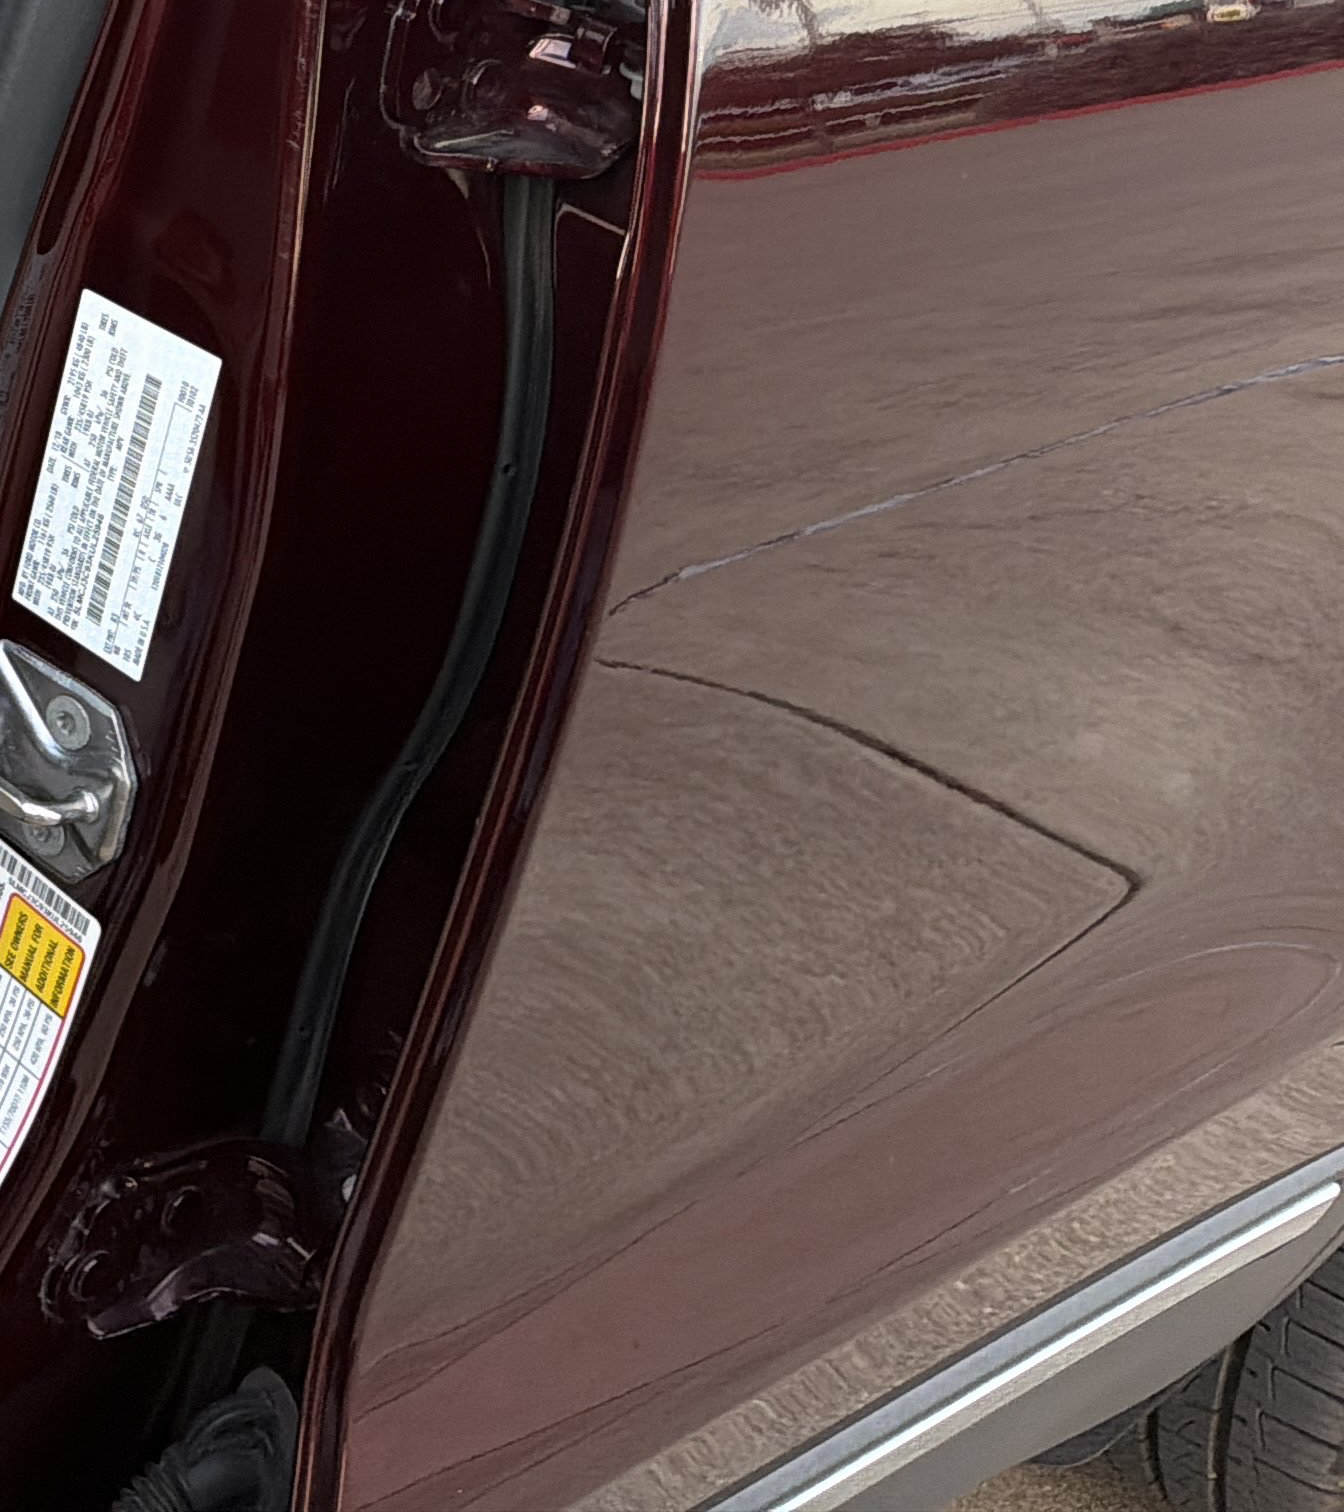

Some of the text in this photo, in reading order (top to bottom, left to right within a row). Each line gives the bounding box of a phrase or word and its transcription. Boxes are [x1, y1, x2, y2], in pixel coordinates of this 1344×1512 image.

[66, 368, 78, 386] 2195
[62, 588, 76, 626] PREVENTION
[71, 550, 85, 586] STANDARDS
[102, 421, 118, 467] MANUFACTURE
[112, 395, 124, 420] SHOWN
[64, 546, 78, 579] CONFORMS
[79, 486, 93, 523] APPLICABLE
[87, 459, 100, 485] FEDERAL
[100, 407, 113, 433] VEHICLE
[4, 949, 16, 969] SEE
[19, 923, 43, 982] MANUAL FOR
[35, 939, 58, 992] ADDITIONAL
[50, 945, 74, 1007] INFORMATION
